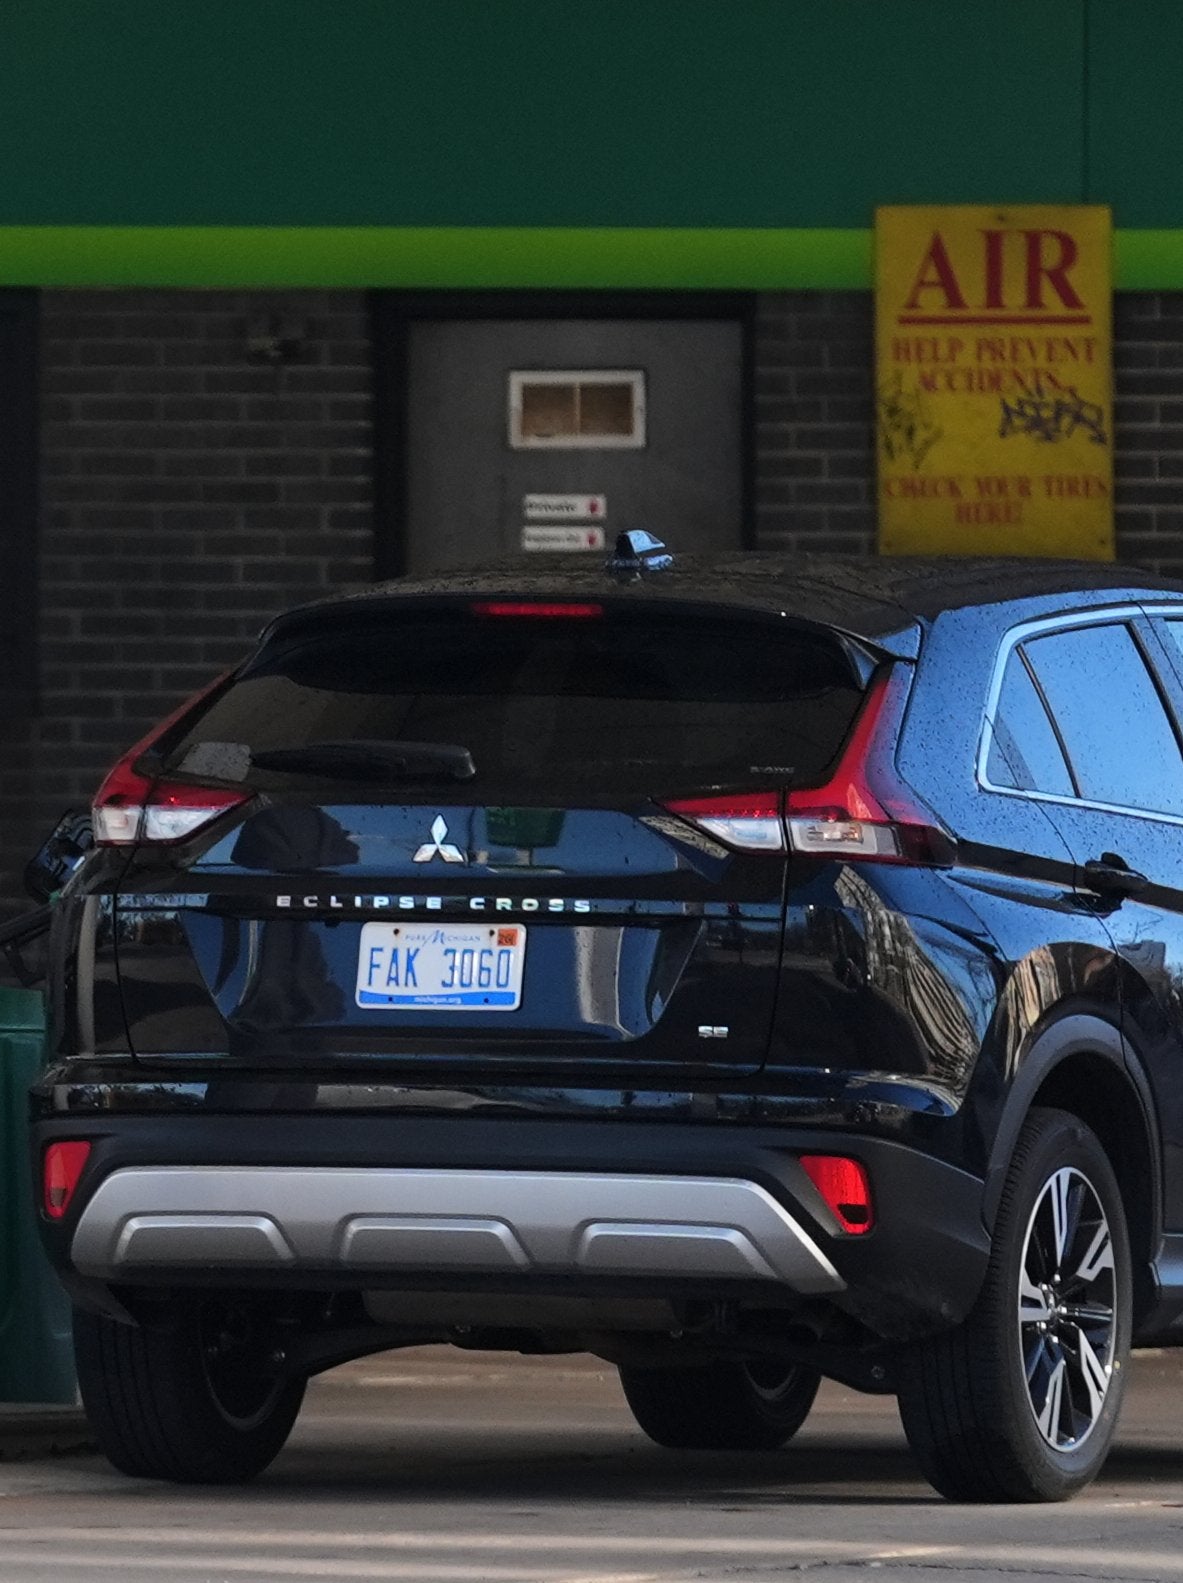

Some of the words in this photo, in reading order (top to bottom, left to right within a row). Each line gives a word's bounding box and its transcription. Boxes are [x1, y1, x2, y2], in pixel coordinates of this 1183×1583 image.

[905, 230, 1086, 309] AIR
[891, 337, 964, 363] HELP
[974, 336, 1096, 364] PREVENT
[884, 476, 963, 498] CHECK
[974, 476, 1032, 498] YOUR
[1041, 475, 1108, 498] TIRES
[276, 895, 442, 911] ECLIPSE
[470, 897, 591, 913] CROSS
[368, 947, 420, 987] FAK
[441, 948, 511, 988] 3060
[698, 1025, 729, 1038] SE
